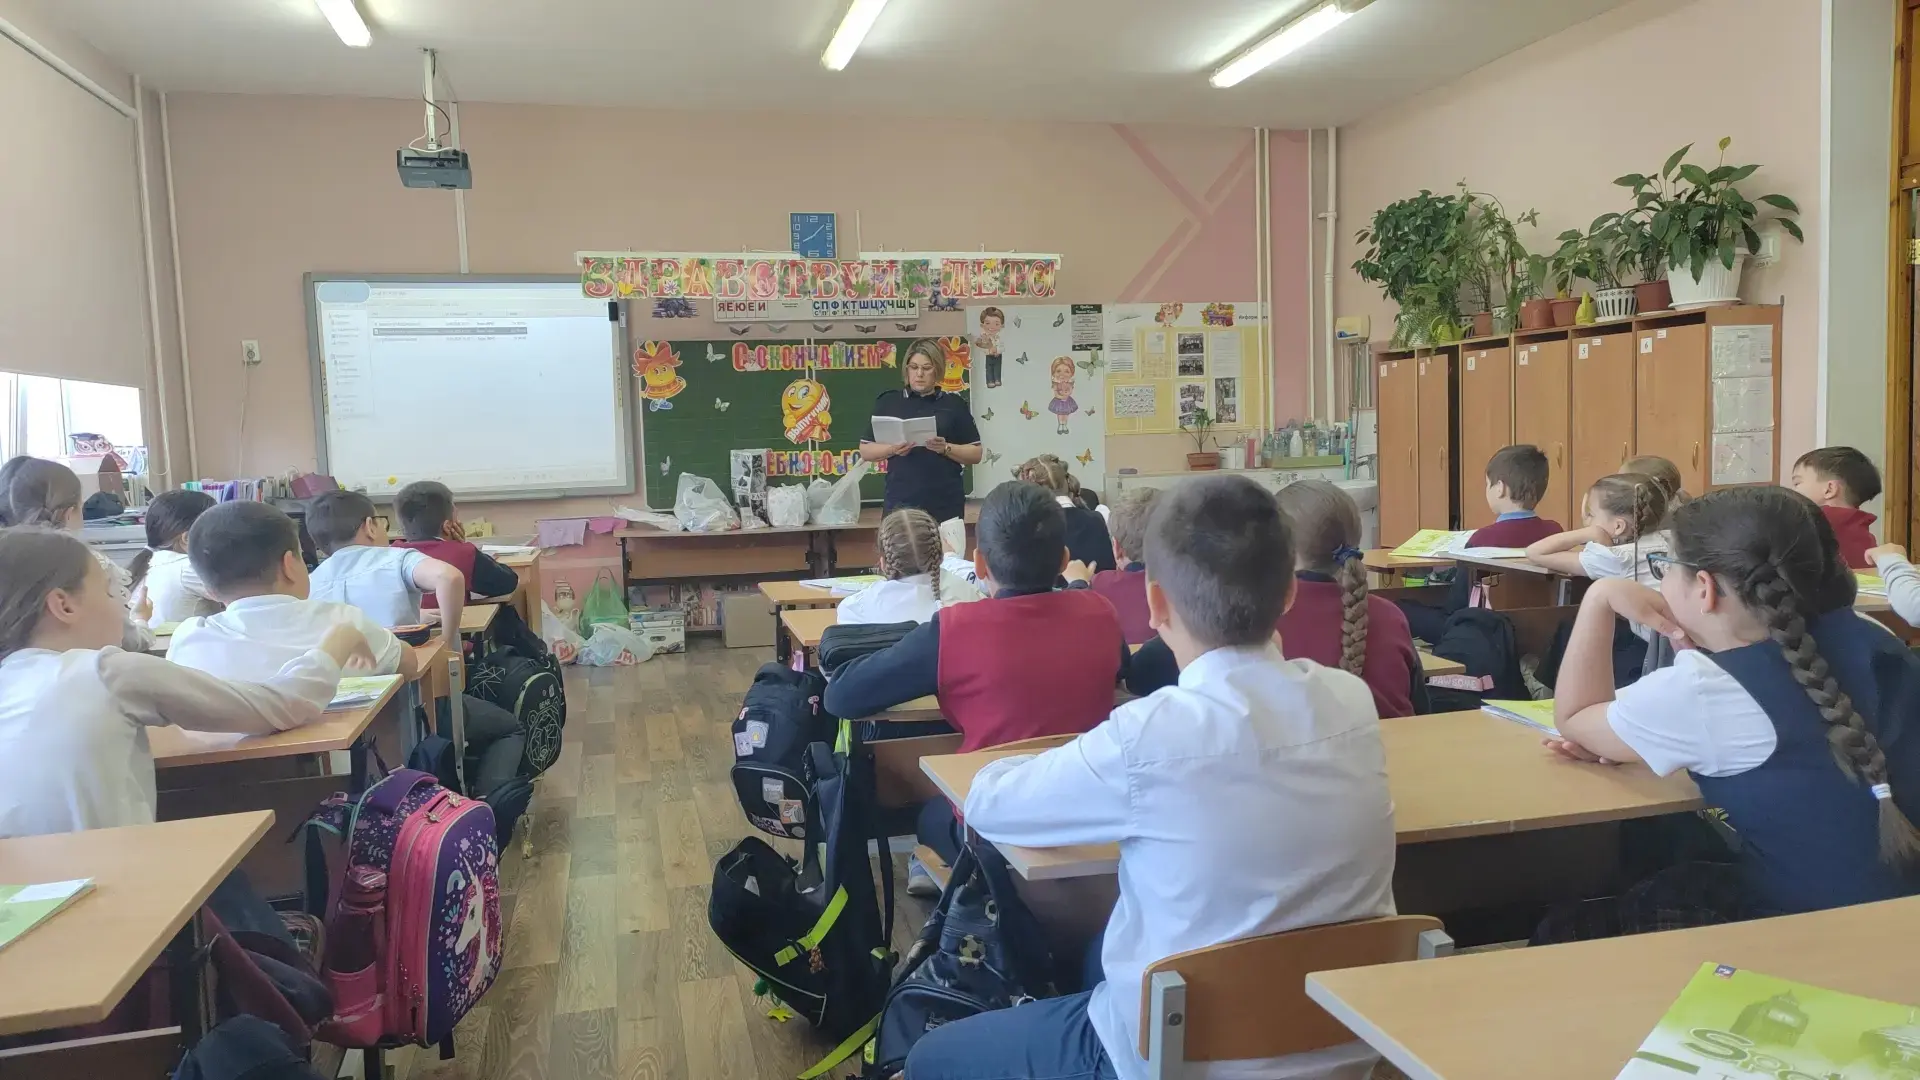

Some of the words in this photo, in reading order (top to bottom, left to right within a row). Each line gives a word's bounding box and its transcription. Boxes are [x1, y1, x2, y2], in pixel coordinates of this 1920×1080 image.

[805, 215, 819, 223] 12
[792, 223, 801, 231] 10
[807, 250, 820, 258] 6
[940, 258, 1056, 299] ЛЕТО!
[754, 344, 882, 370] ОКОНЧАНИЕМ
